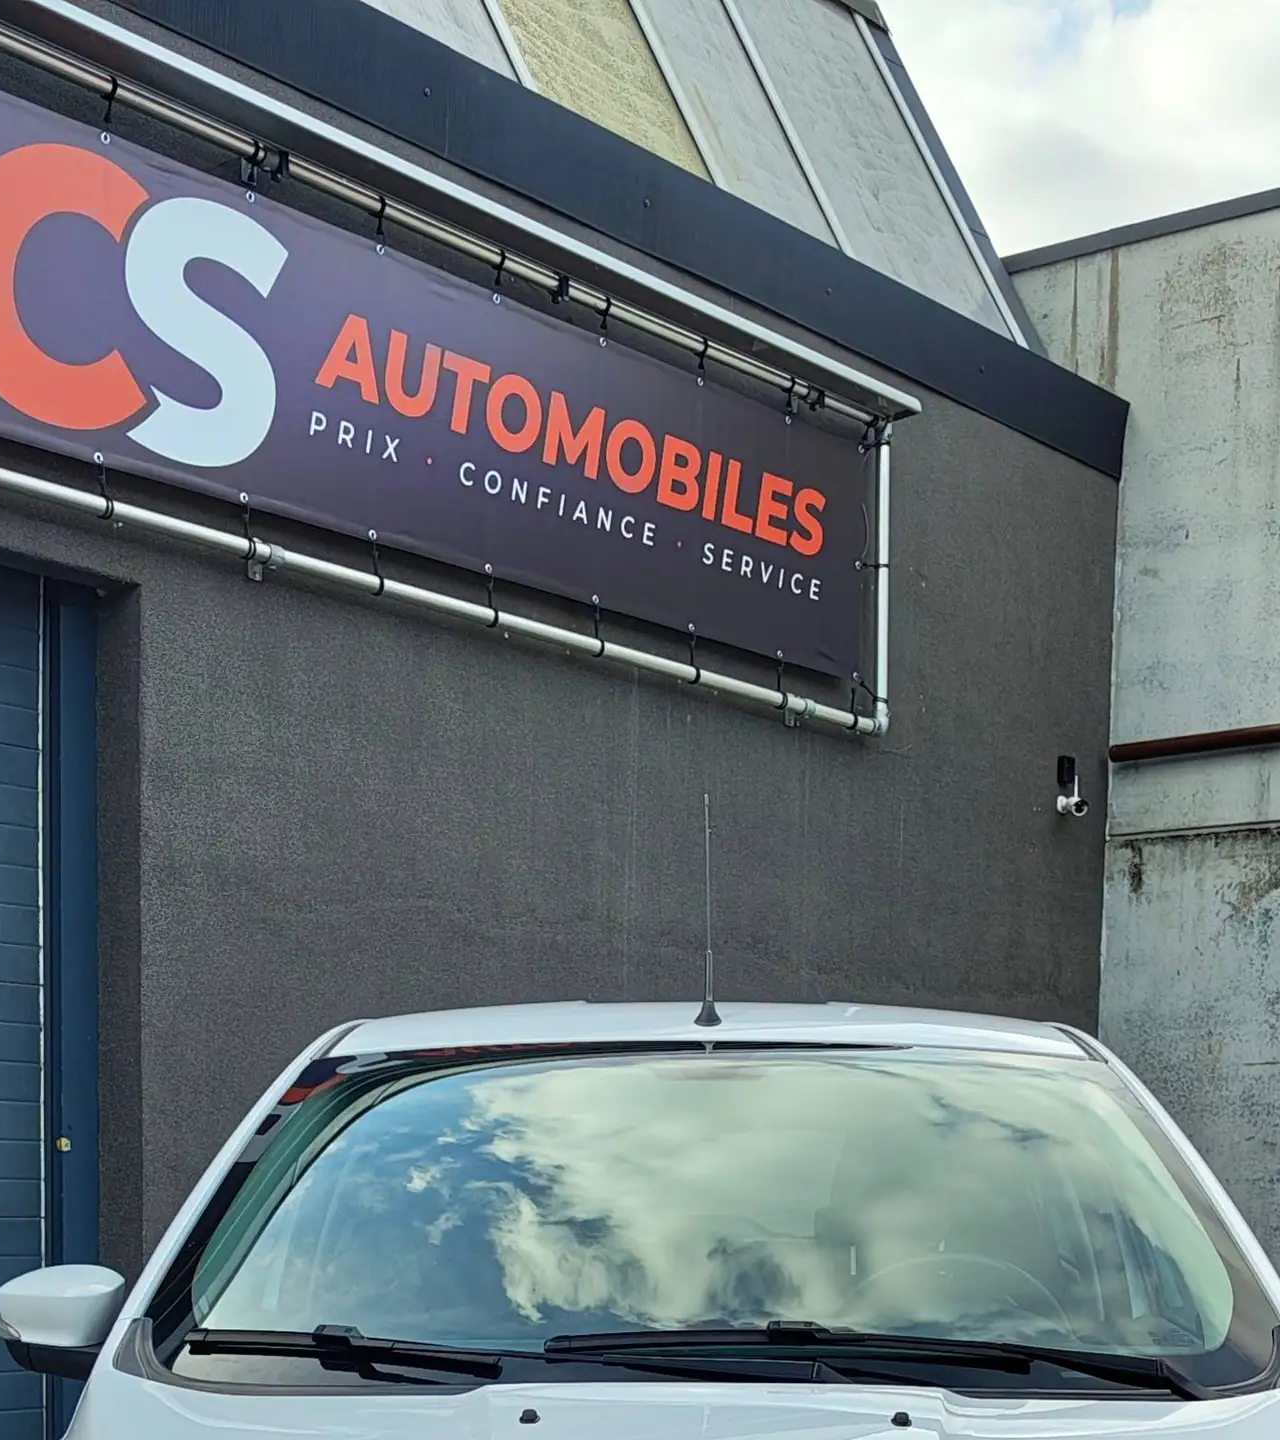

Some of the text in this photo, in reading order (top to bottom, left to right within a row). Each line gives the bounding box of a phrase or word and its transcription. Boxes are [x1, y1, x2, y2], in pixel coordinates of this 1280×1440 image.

[309, 411, 821, 601] PRIX CONFIANCE SERVICE
[315, 314, 826, 556] AUTOMOBILES
